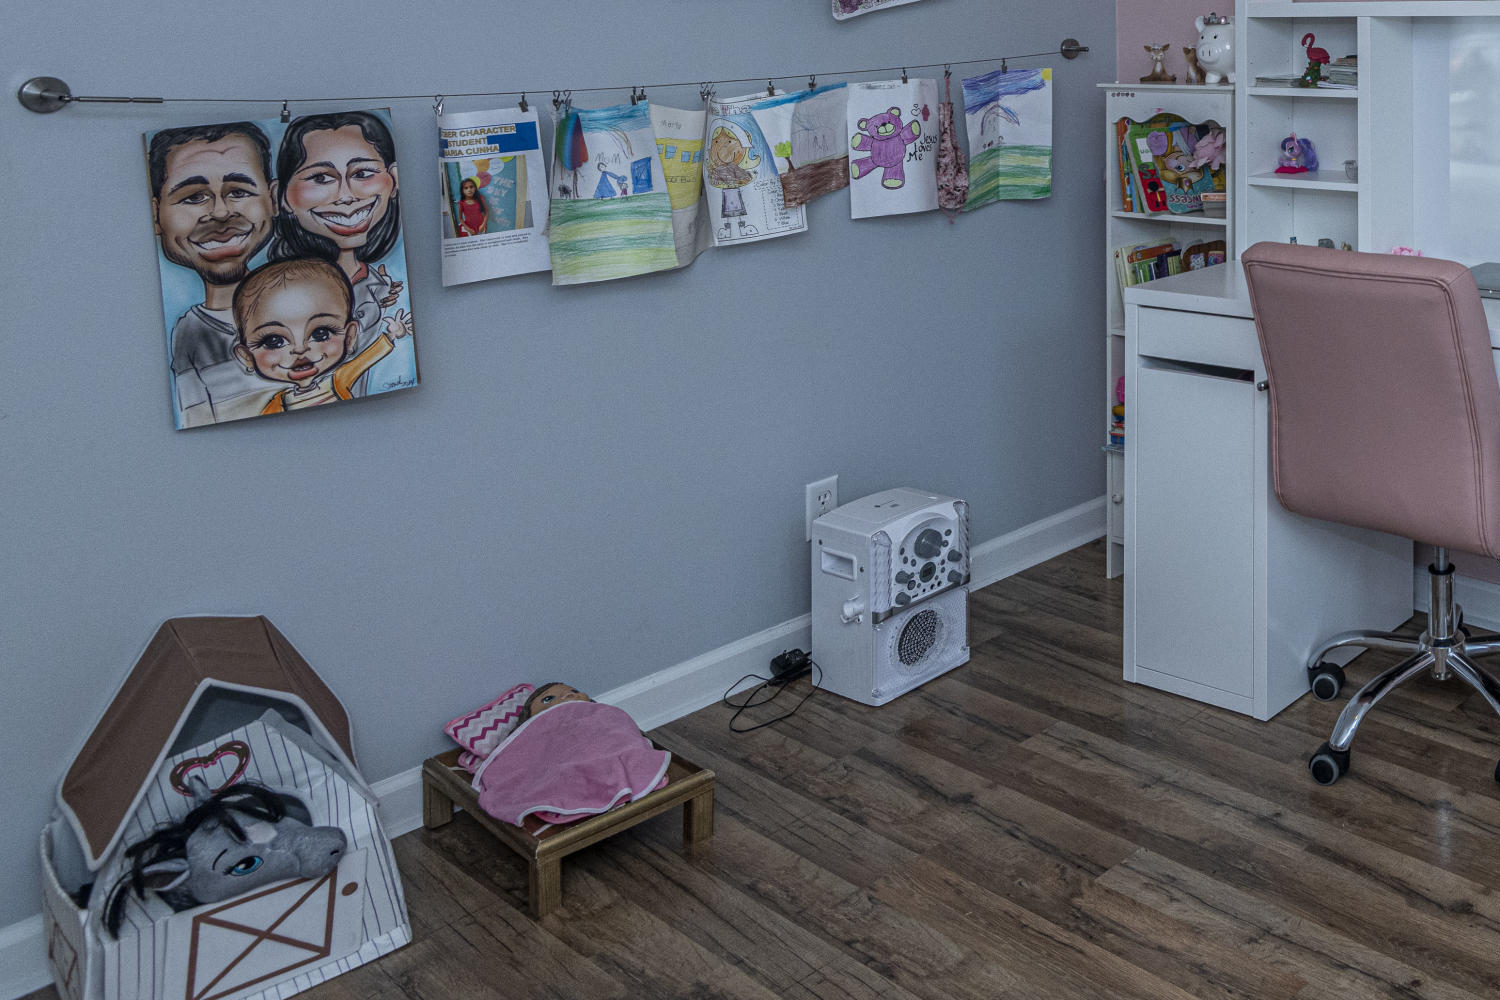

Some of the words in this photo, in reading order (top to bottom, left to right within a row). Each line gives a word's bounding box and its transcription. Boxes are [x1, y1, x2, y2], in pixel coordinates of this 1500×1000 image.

[459, 125, 516, 137] CHARACTER
[447, 137, 487, 148] STUDENT
[920, 133, 938, 145] Jesus
[465, 145, 499, 155] CUNHA
[906, 152, 924, 162] Me
